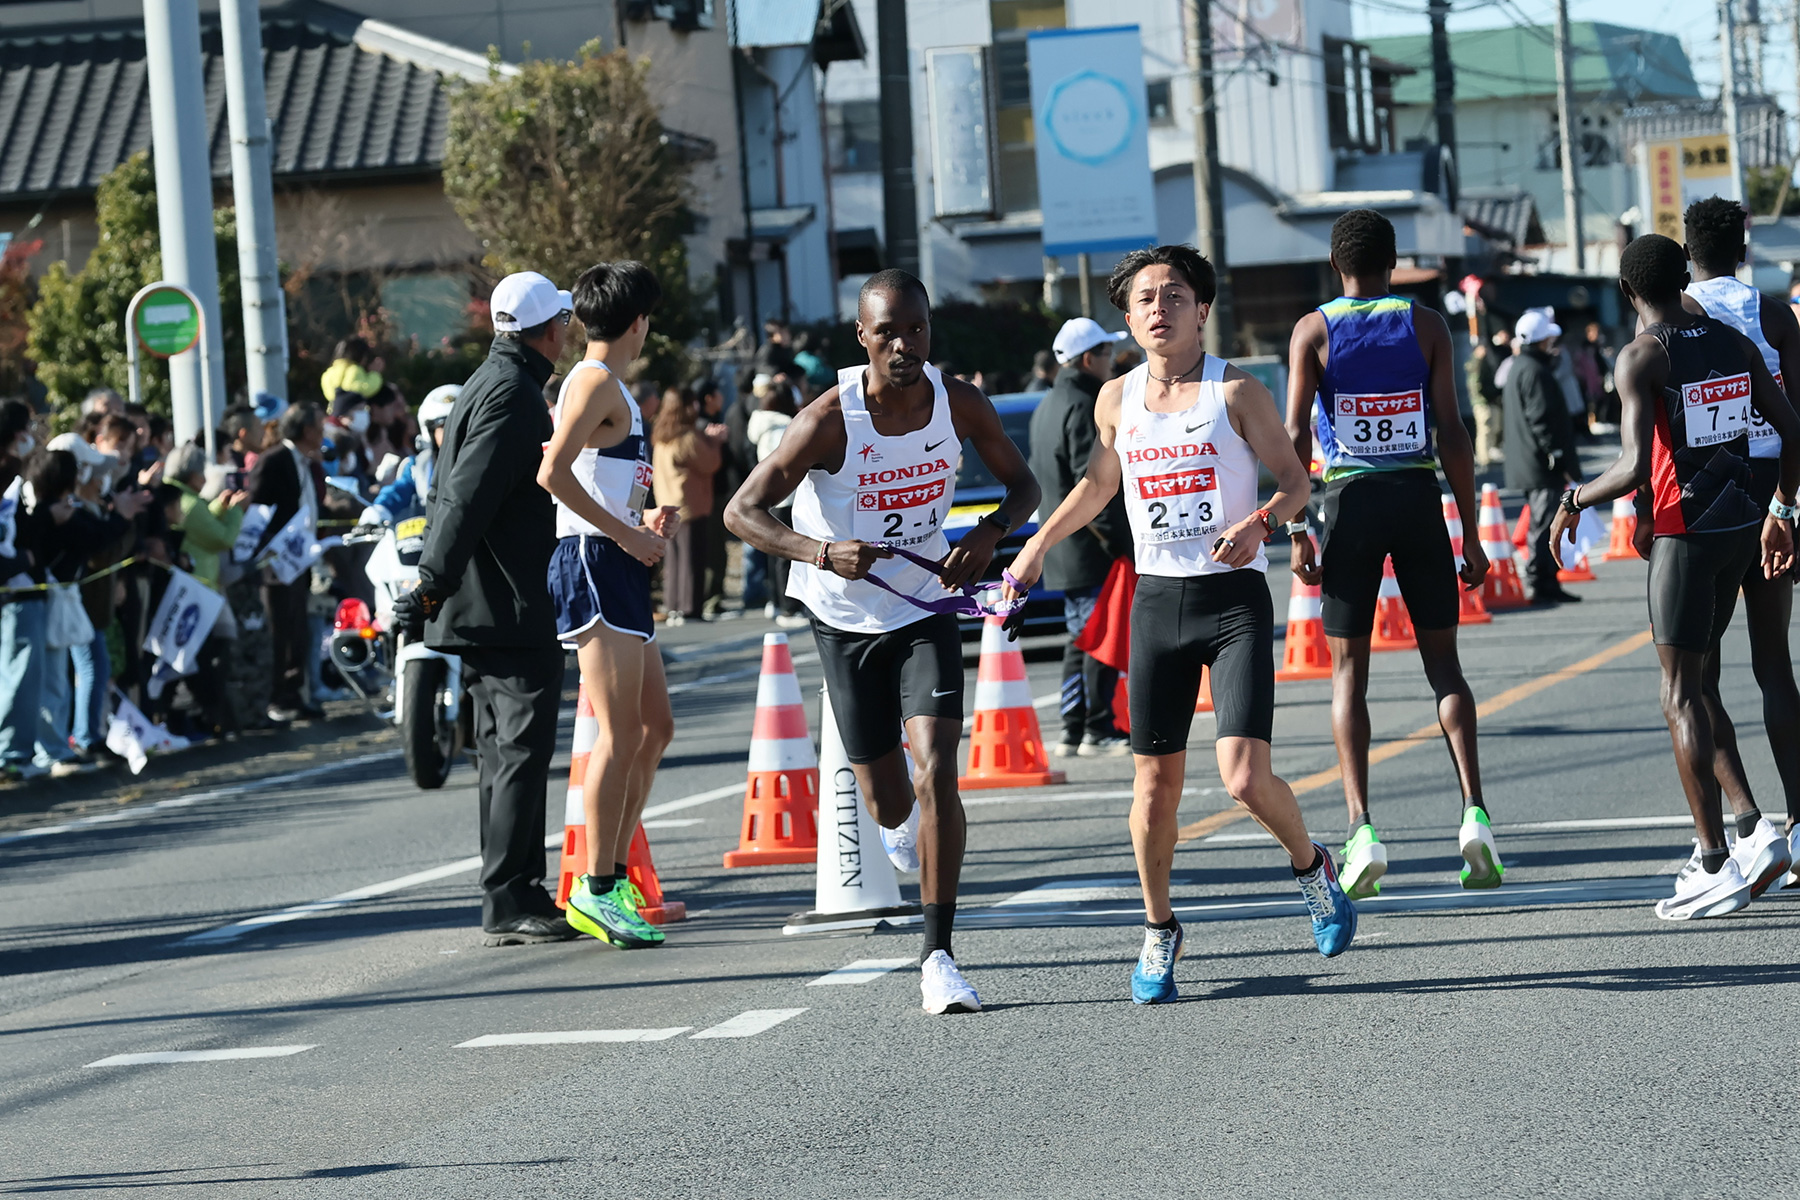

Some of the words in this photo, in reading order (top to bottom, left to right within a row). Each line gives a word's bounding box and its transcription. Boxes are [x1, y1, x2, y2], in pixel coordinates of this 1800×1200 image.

[1703, 380, 1748, 399] ヤマザキ
[1360, 397, 1417, 413] ヤマザキ
[1354, 419, 1418, 442] 38-4
[1126, 442, 1219, 464] HONDA
[857, 458, 950, 487] HONDA
[1143, 473, 1212, 495] ヤマザキ
[882, 484, 943, 507] ヤマザキ
[834, 767, 863, 889] CITIZEN
